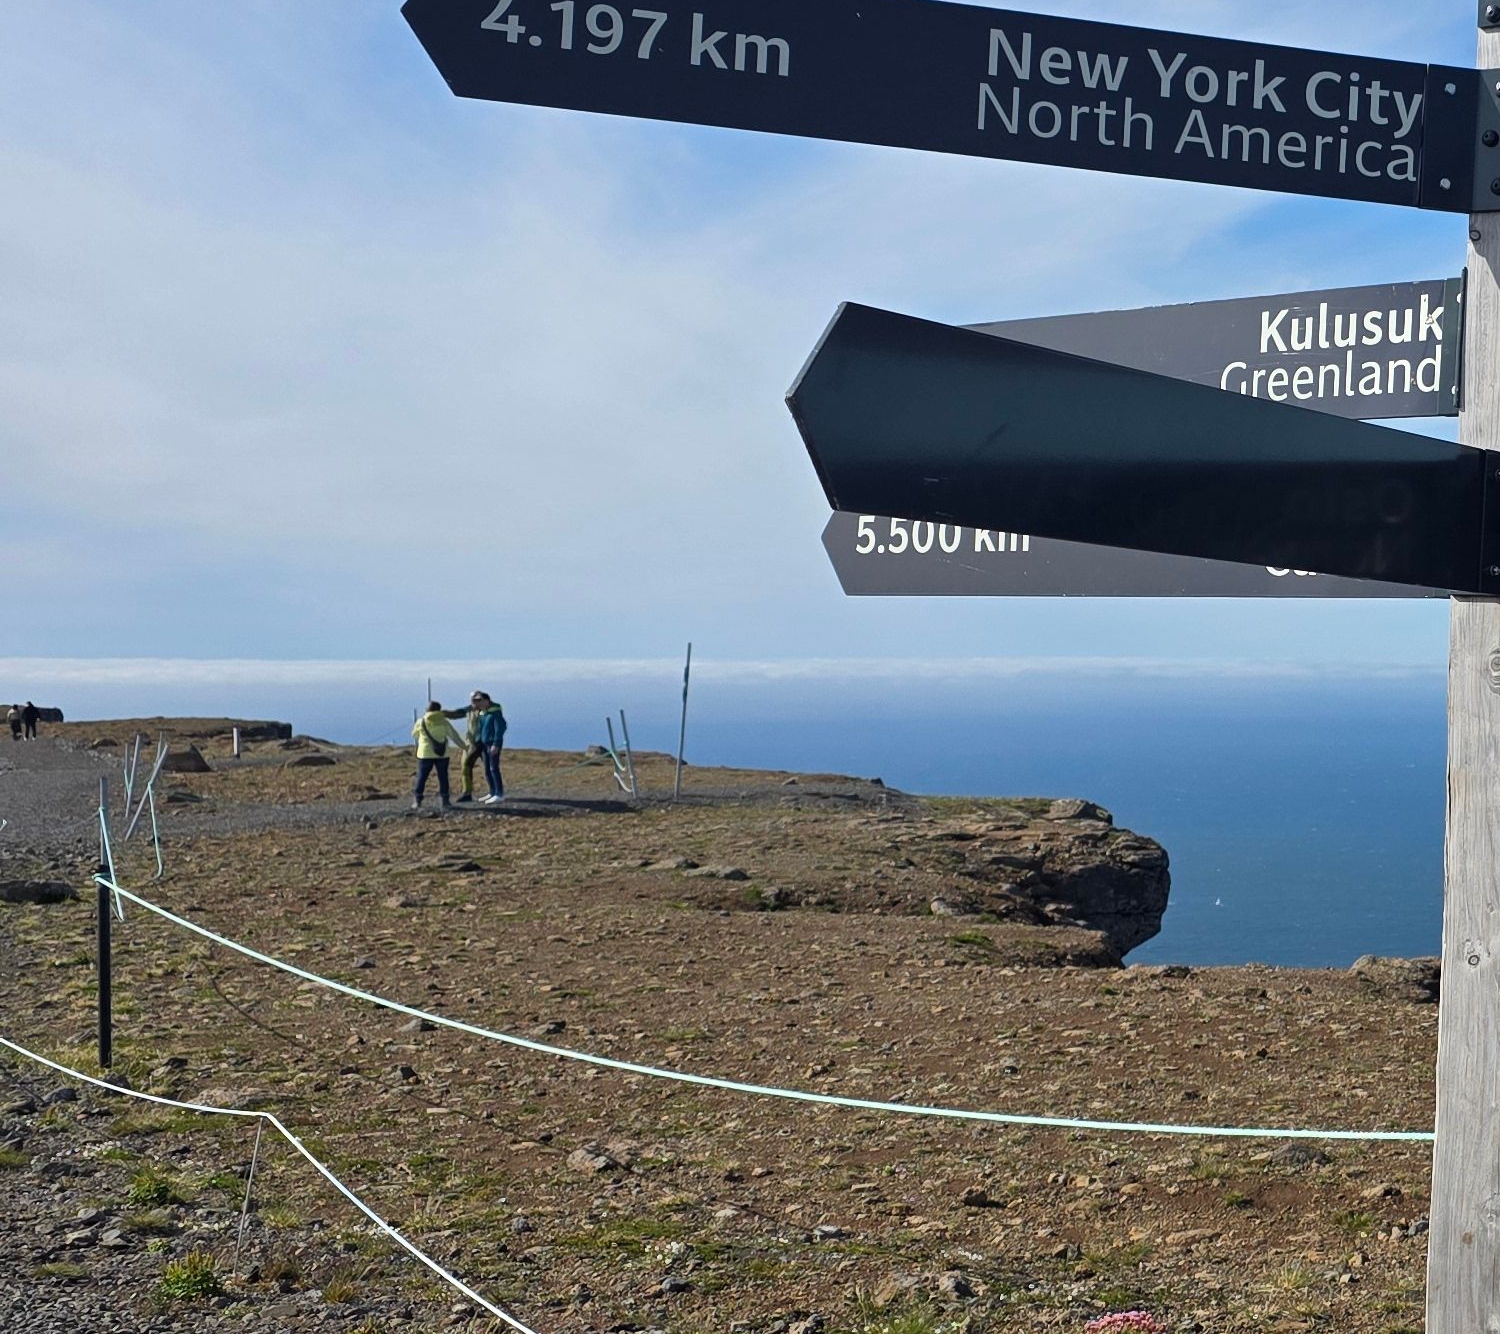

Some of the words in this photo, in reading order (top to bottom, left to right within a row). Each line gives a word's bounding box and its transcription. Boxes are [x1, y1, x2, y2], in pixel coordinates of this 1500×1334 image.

[690, 13, 791, 77] km
[987, 28, 1129, 92] New
[1147, 48, 1286, 113] York
[1305, 72, 1423, 139] City
[977, 82, 1154, 151] North
[1174, 108, 1417, 182] America
[1260, 293, 1444, 353] Kulusuk
[1219, 344, 1442, 402] Greenland
[855, 515, 962, 554] 5.500
